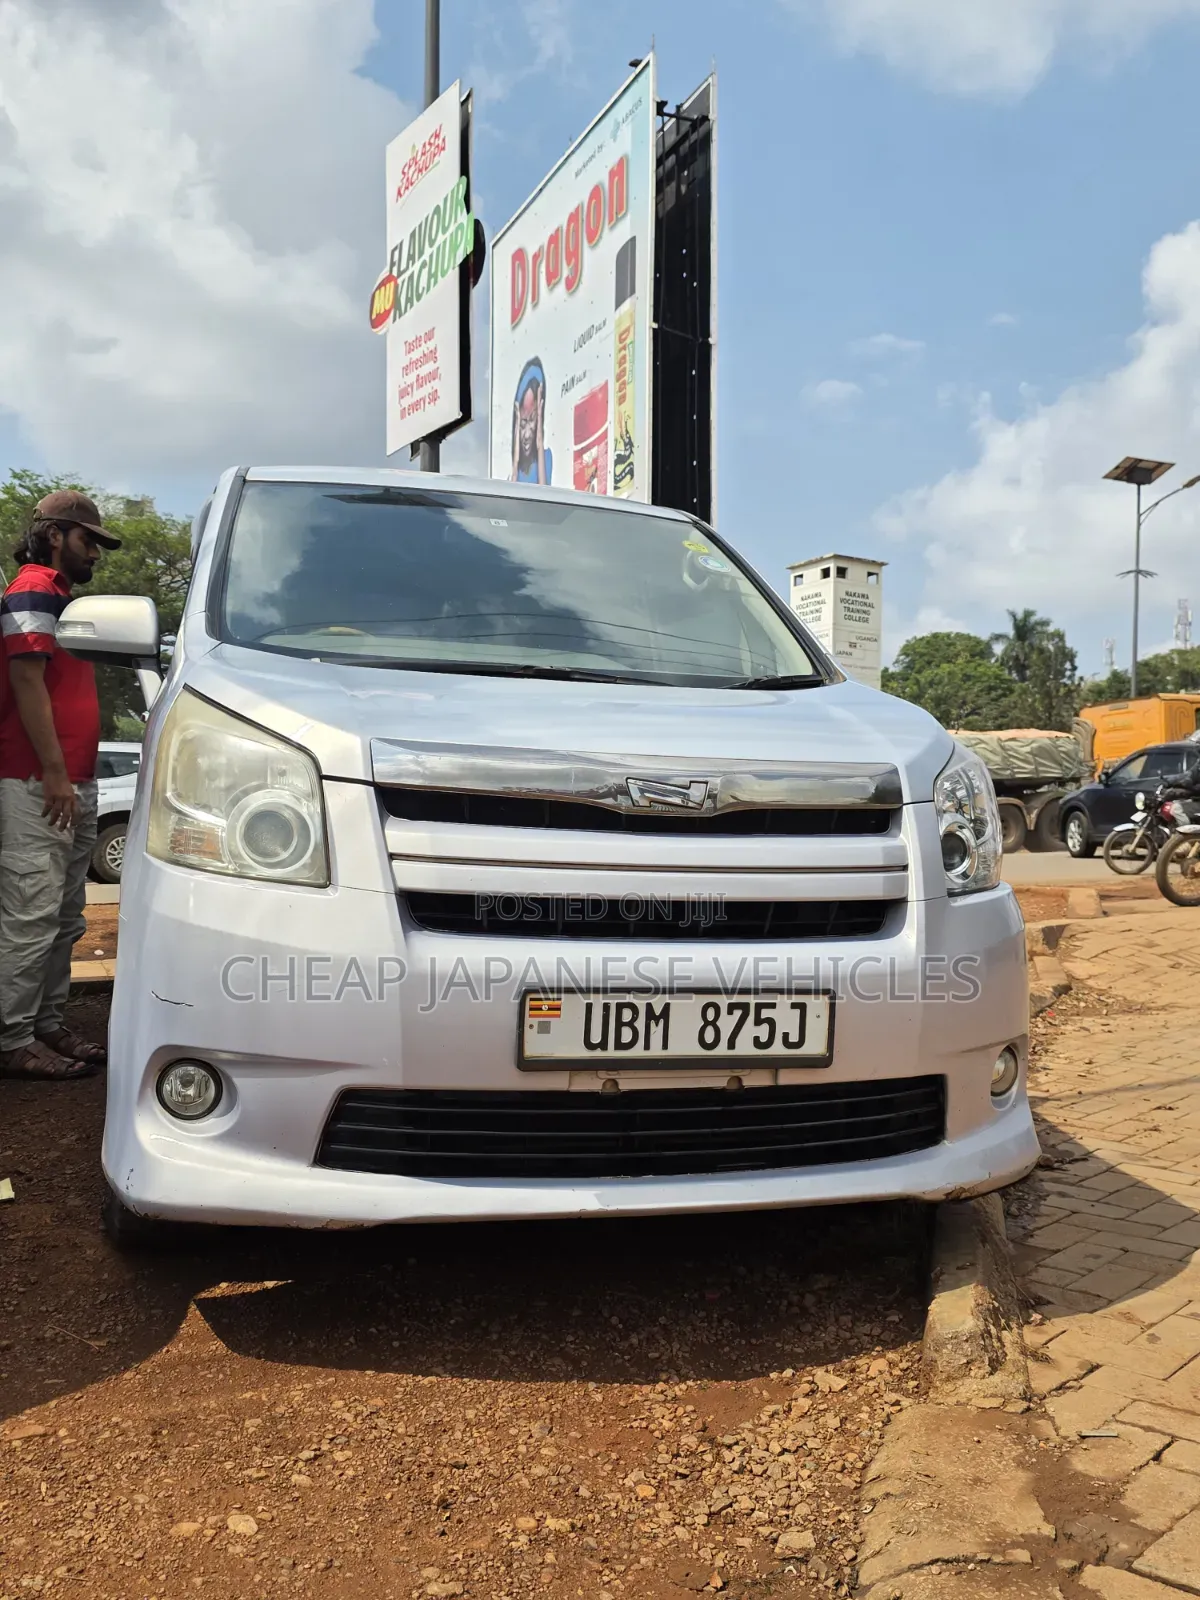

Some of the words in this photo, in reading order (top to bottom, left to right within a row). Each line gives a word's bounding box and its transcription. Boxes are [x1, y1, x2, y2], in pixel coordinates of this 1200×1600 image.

[401, 123, 442, 183] SPLASH
[389, 177, 467, 279] FLAVOUR
[511, 155, 627, 328] Dragon
[392, 211, 474, 324] KACHUPA
[371, 281, 394, 320] MU
[404, 335, 422, 356] Taste
[424, 327, 435, 344] our
[573, 323, 594, 353] LIQUID
[402, 344, 437, 378] refreshing
[398, 380, 414, 407] juicy
[416, 366, 442, 390] flavour,
[561, 374, 575, 398] PAIN
[400, 404, 406, 420] in
[407, 395, 426, 416] every
[428, 386, 440, 406] sip.
[796, 599, 826, 610] VOCATIONAL
[840, 597, 875, 609] VOCATIONAL
[845, 590, 869, 600] NAKAWA
[799, 607, 822, 617] TRAINING
[843, 606, 870, 616] TRAINING
[844, 614, 869, 624] COLLEGE
[855, 635, 878, 643] UGANDA
[583, 1002, 671, 1051] UBM
[698, 1001, 807, 1051] 875J
